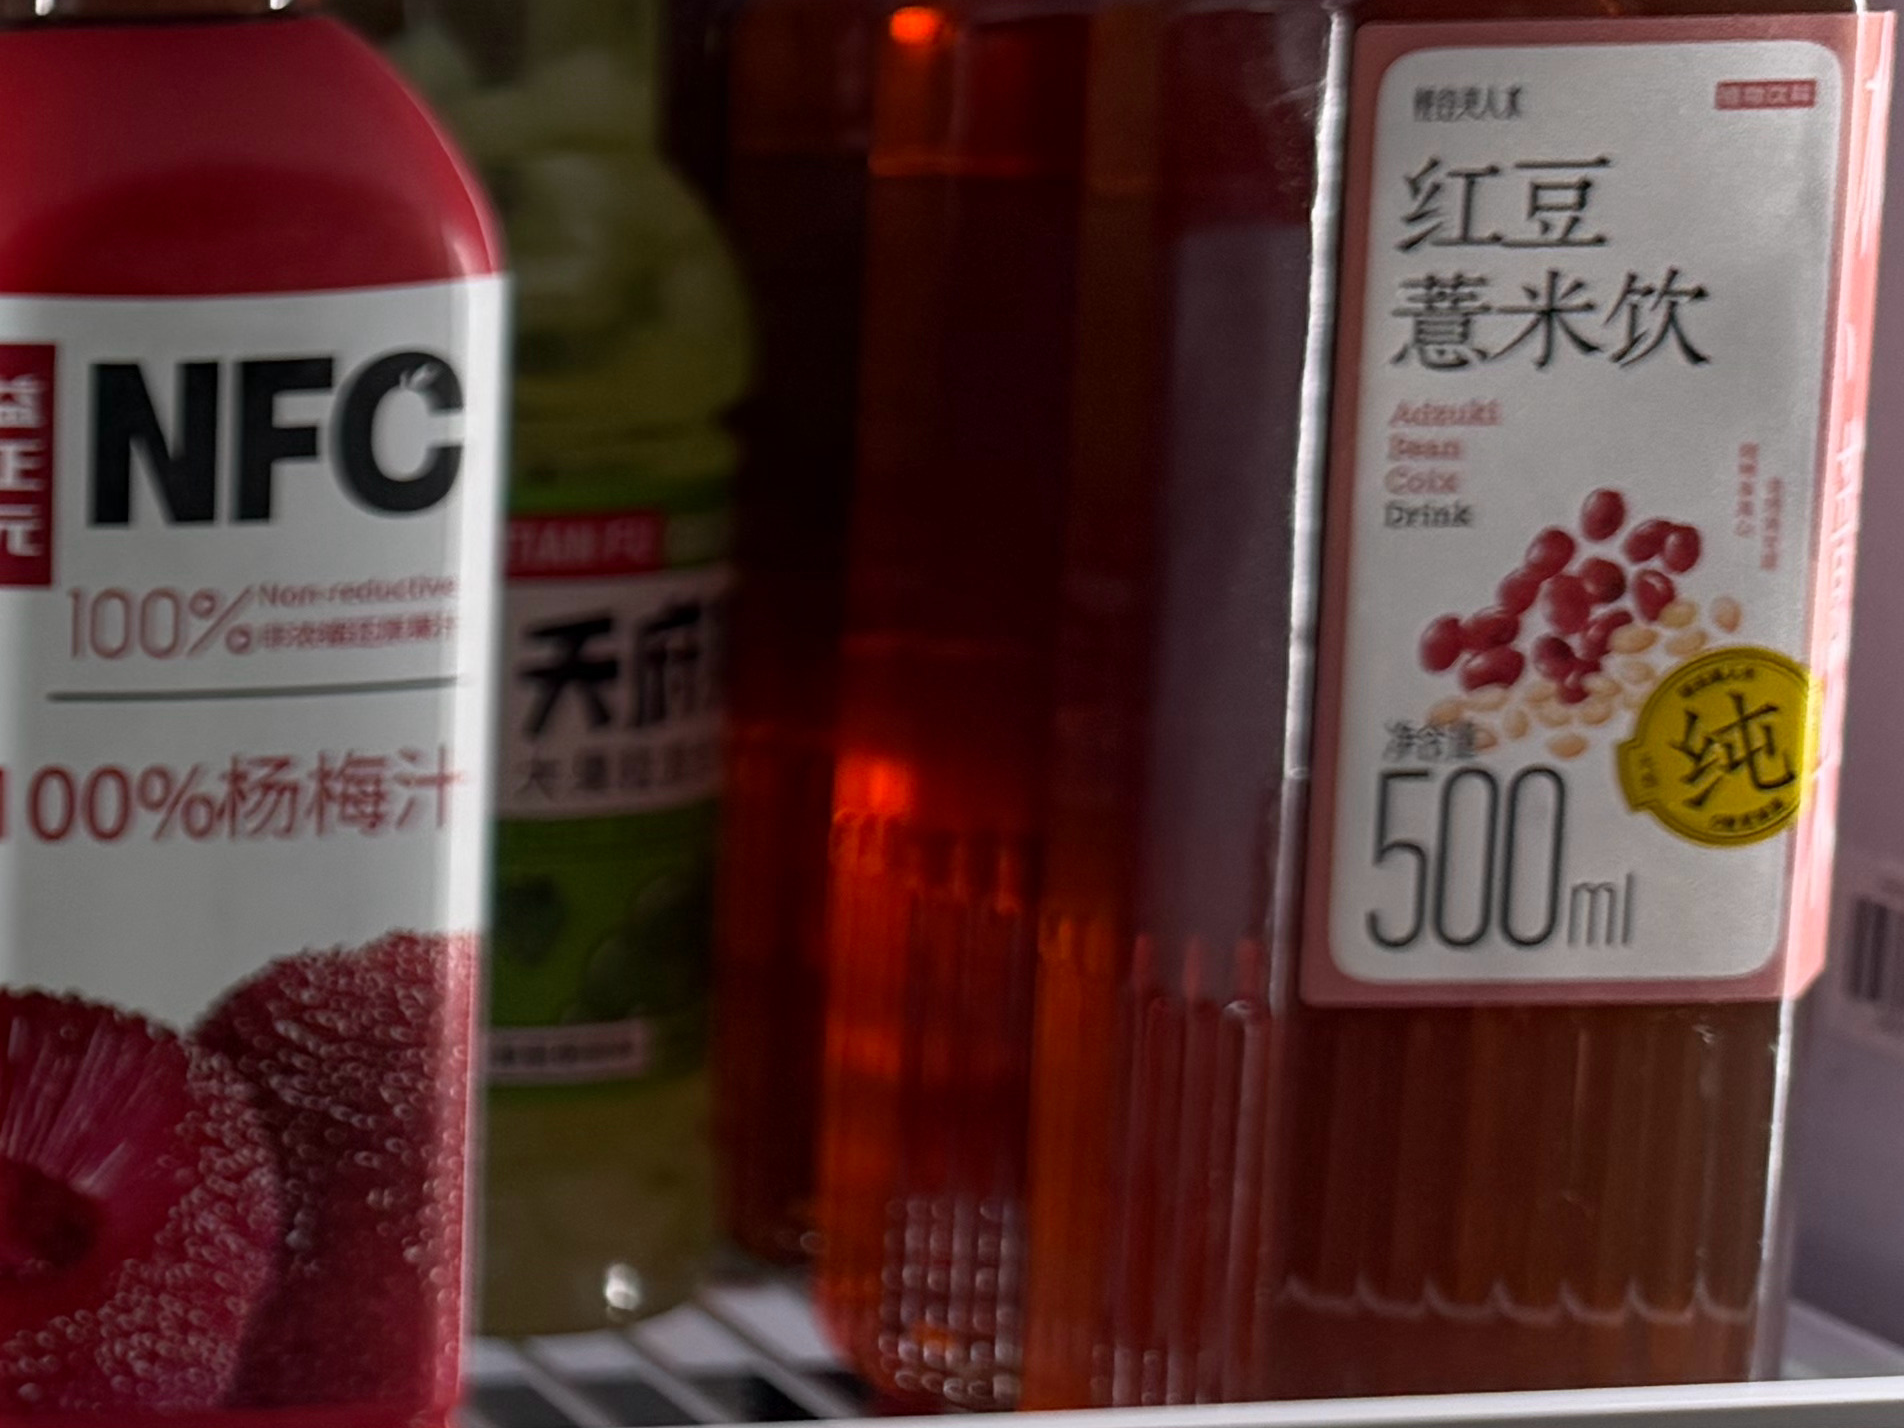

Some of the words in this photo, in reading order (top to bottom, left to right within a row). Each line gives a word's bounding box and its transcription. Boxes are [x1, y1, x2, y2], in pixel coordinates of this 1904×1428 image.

[1395, 156, 1612, 252] 红豆
[1392, 269, 1712, 370] 薏米饮
[86, 352, 465, 529] NFC
[1384, 499, 1474, 528] Drink
[69, 585, 252, 660] 100%
[1670, 691, 1798, 808] 纯
